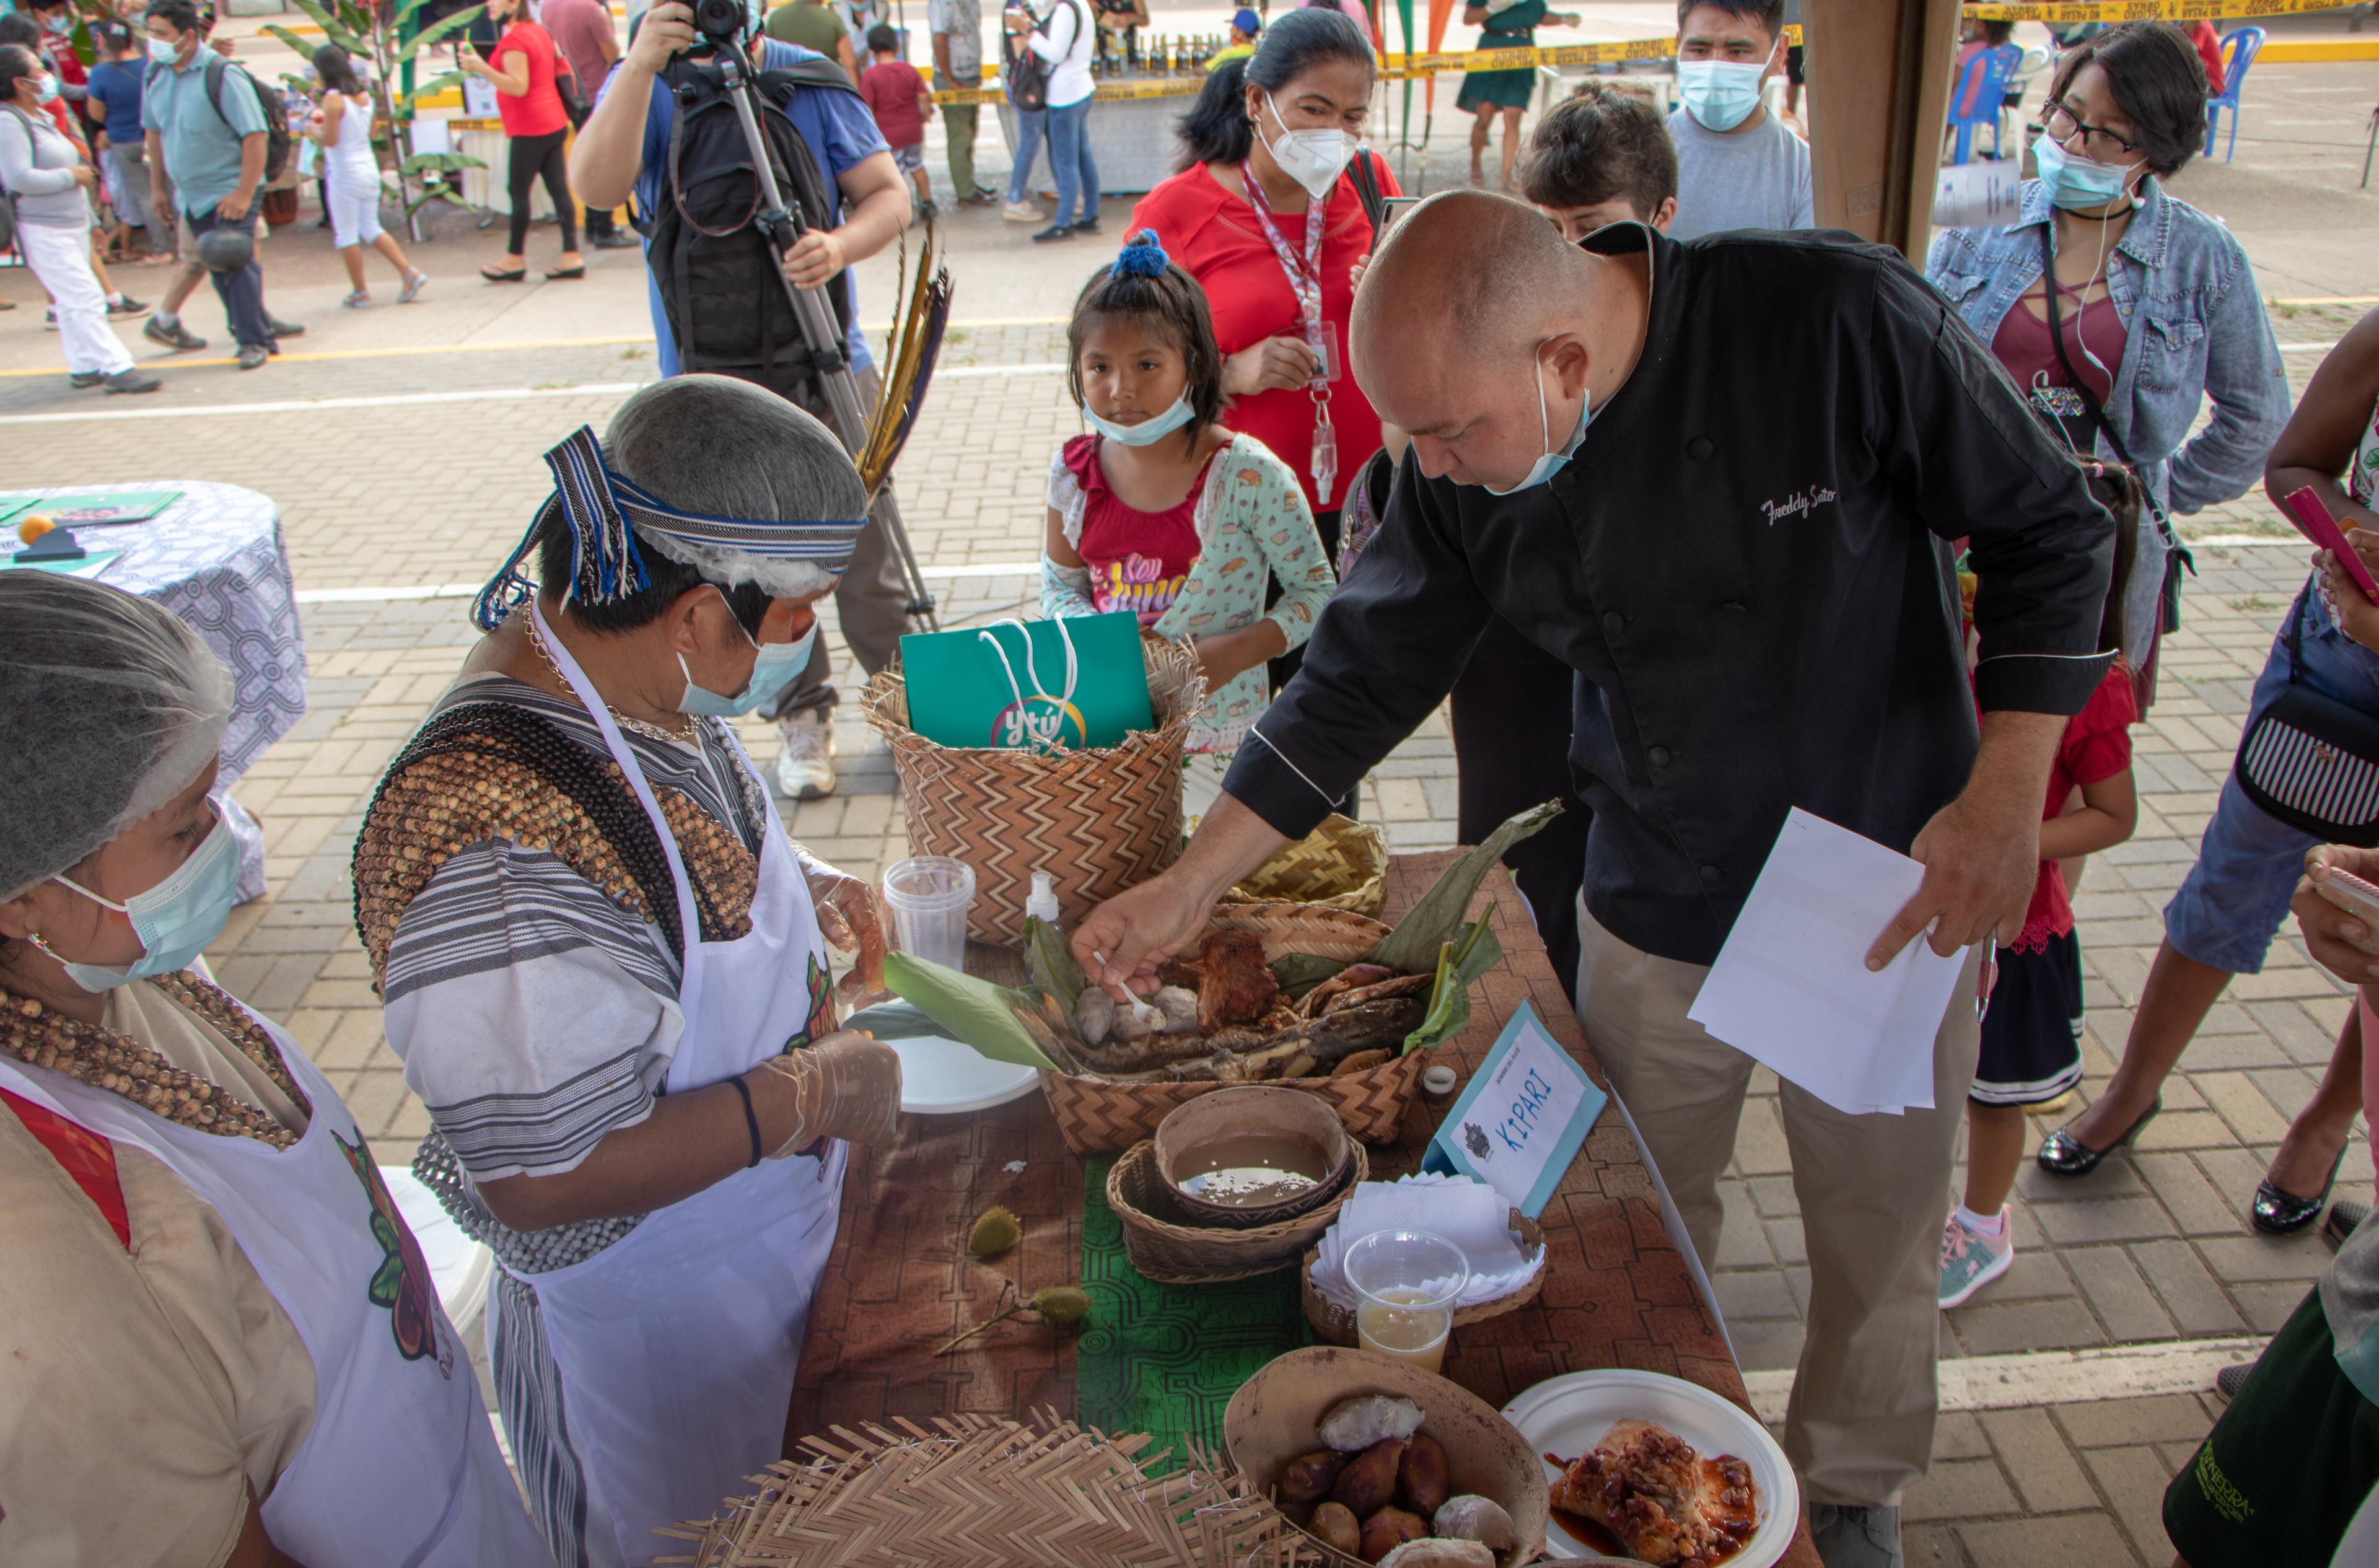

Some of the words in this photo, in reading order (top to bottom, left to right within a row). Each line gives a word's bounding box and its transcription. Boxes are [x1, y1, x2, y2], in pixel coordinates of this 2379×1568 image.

[2127, 2, 2160, 10] OBRAS
[2002, 10, 2042, 20] PELIGRO
[2061, 9, 2086, 20] PASAR
[2087, 9, 2100, 19] NO
[2124, 9, 2163, 19] PELIGRO
[2182, 7, 2209, 18] PASAR
[2210, 7, 2222, 17] NO
[1556, 51, 1584, 63] PASAR
[1587, 50, 1599, 61] NO
[1625, 46, 1668, 59] PELIGRO
[1491, 56, 1534, 68] PELIGRO
[1760, 491, 1809, 526] Freddy
[1496, 1065, 1509, 1085] NOMBRE
[1512, 1046, 1521, 1061] PLATO
[1494, 1067, 1551, 1152] KIPARI
